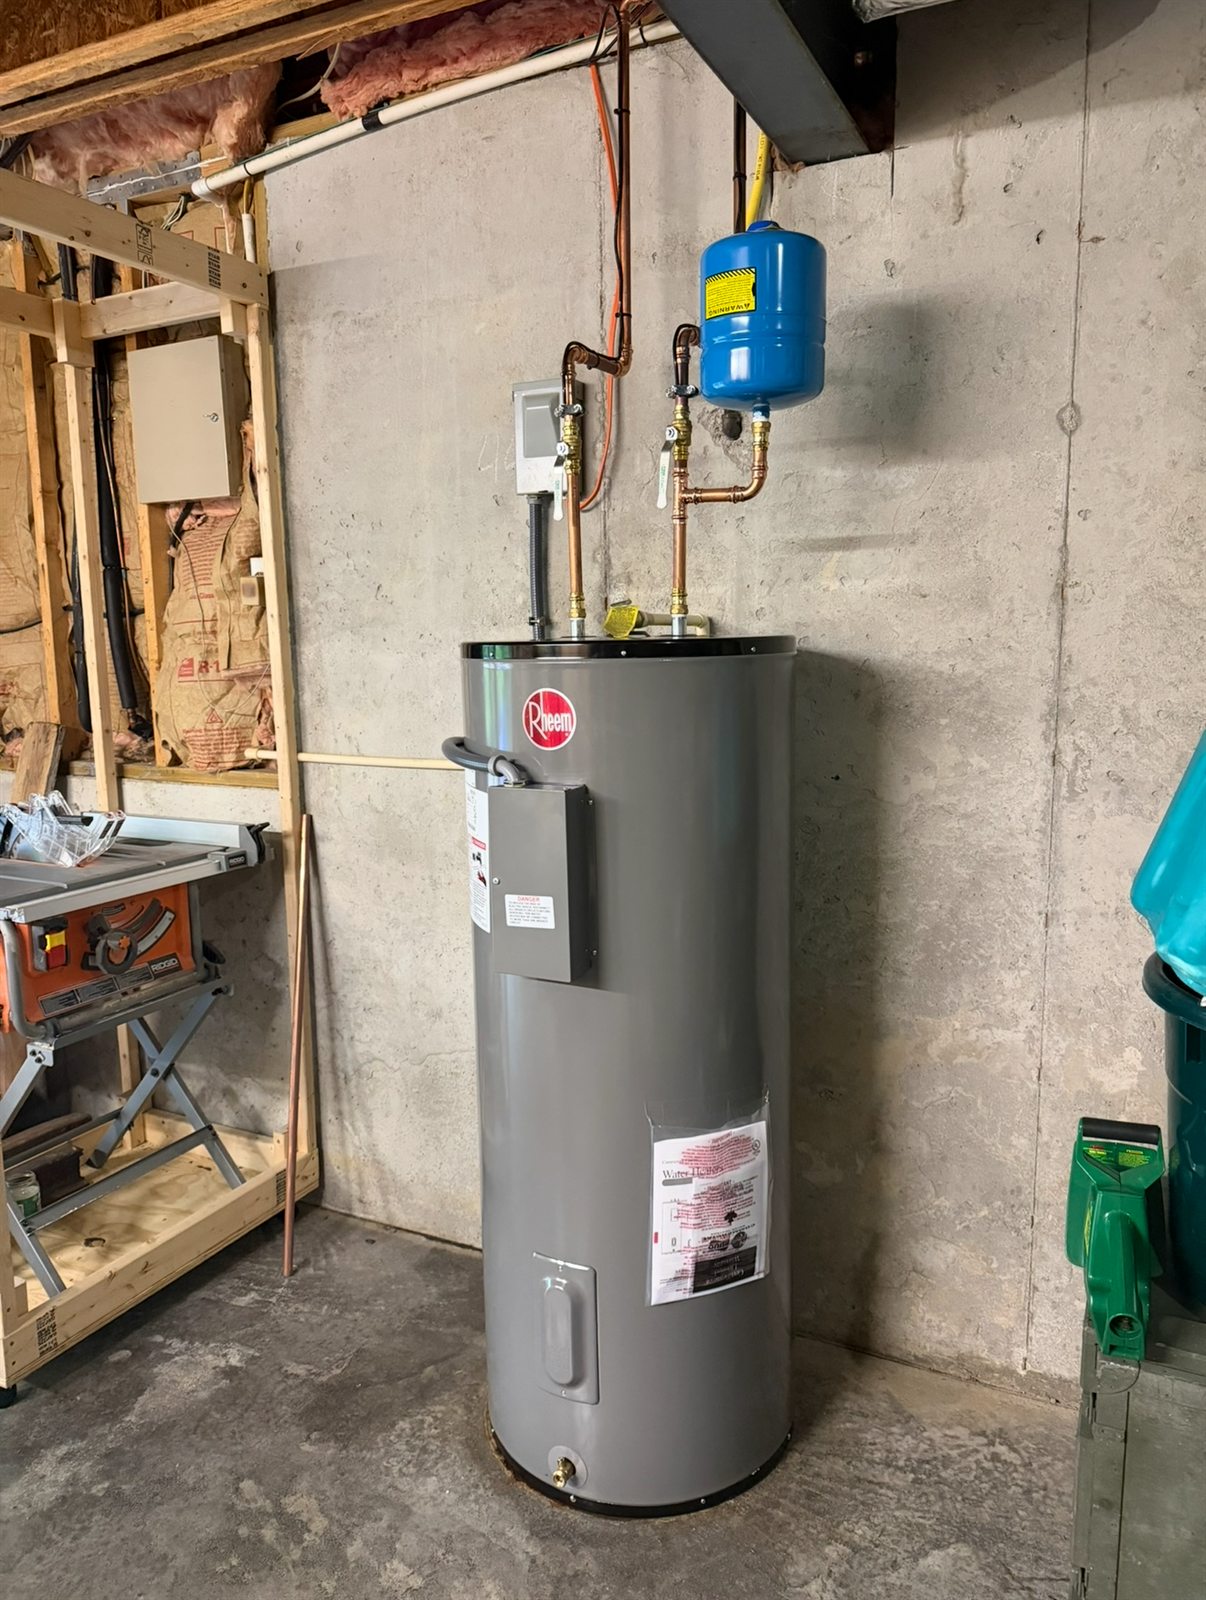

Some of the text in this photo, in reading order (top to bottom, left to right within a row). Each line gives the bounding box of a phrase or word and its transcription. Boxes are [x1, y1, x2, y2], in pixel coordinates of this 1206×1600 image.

[708, 303, 744, 316] WARNING
[529, 691, 572, 740] Rheem
[151, 957, 178, 972] RIDGID
[662, 1169, 689, 1179] Water
